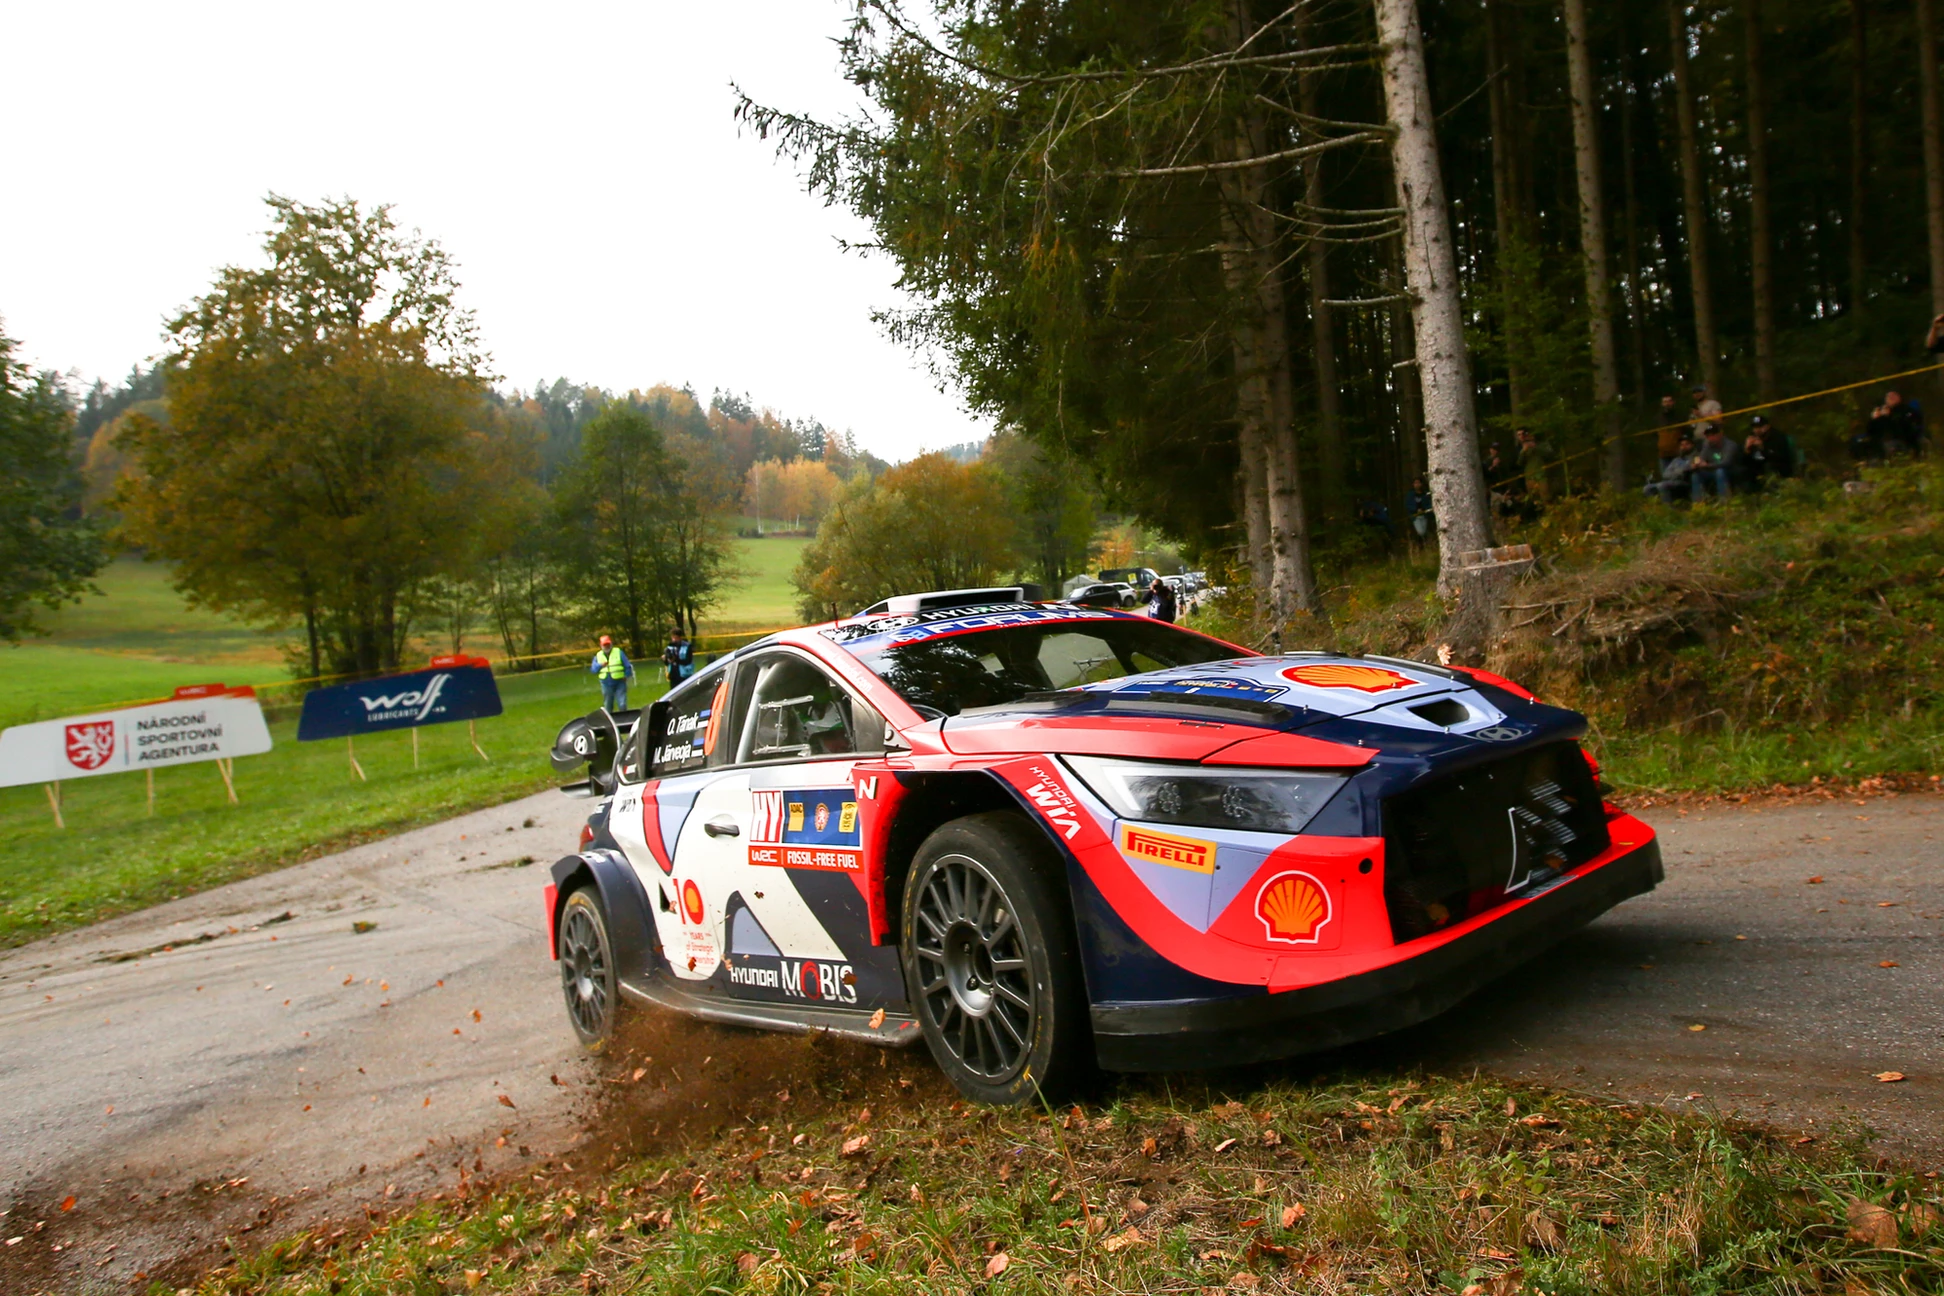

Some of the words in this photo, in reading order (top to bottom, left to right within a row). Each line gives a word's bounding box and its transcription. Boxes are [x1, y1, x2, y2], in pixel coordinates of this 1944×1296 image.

[137, 711, 206, 730] NÁRODNÍ
[667, 717, 676, 736] O.
[703, 681, 729, 756] 8
[137, 724, 223, 746] SPORTOVNÍ
[138, 742, 219, 761] AGENTURA
[858, 776, 877, 800] N
[1029, 766, 1076, 809] HYUNDAI
[1026, 783, 1081, 840] WIA
[751, 850, 778, 863] WRC
[787, 851, 836, 867] FOSSIL-FREE
[837, 854, 859, 868] FUEL
[1128, 831, 1207, 866] PIRELLI
[730, 967, 779, 988] HYUNDAI
[781, 961, 858, 1003] MOBIS
